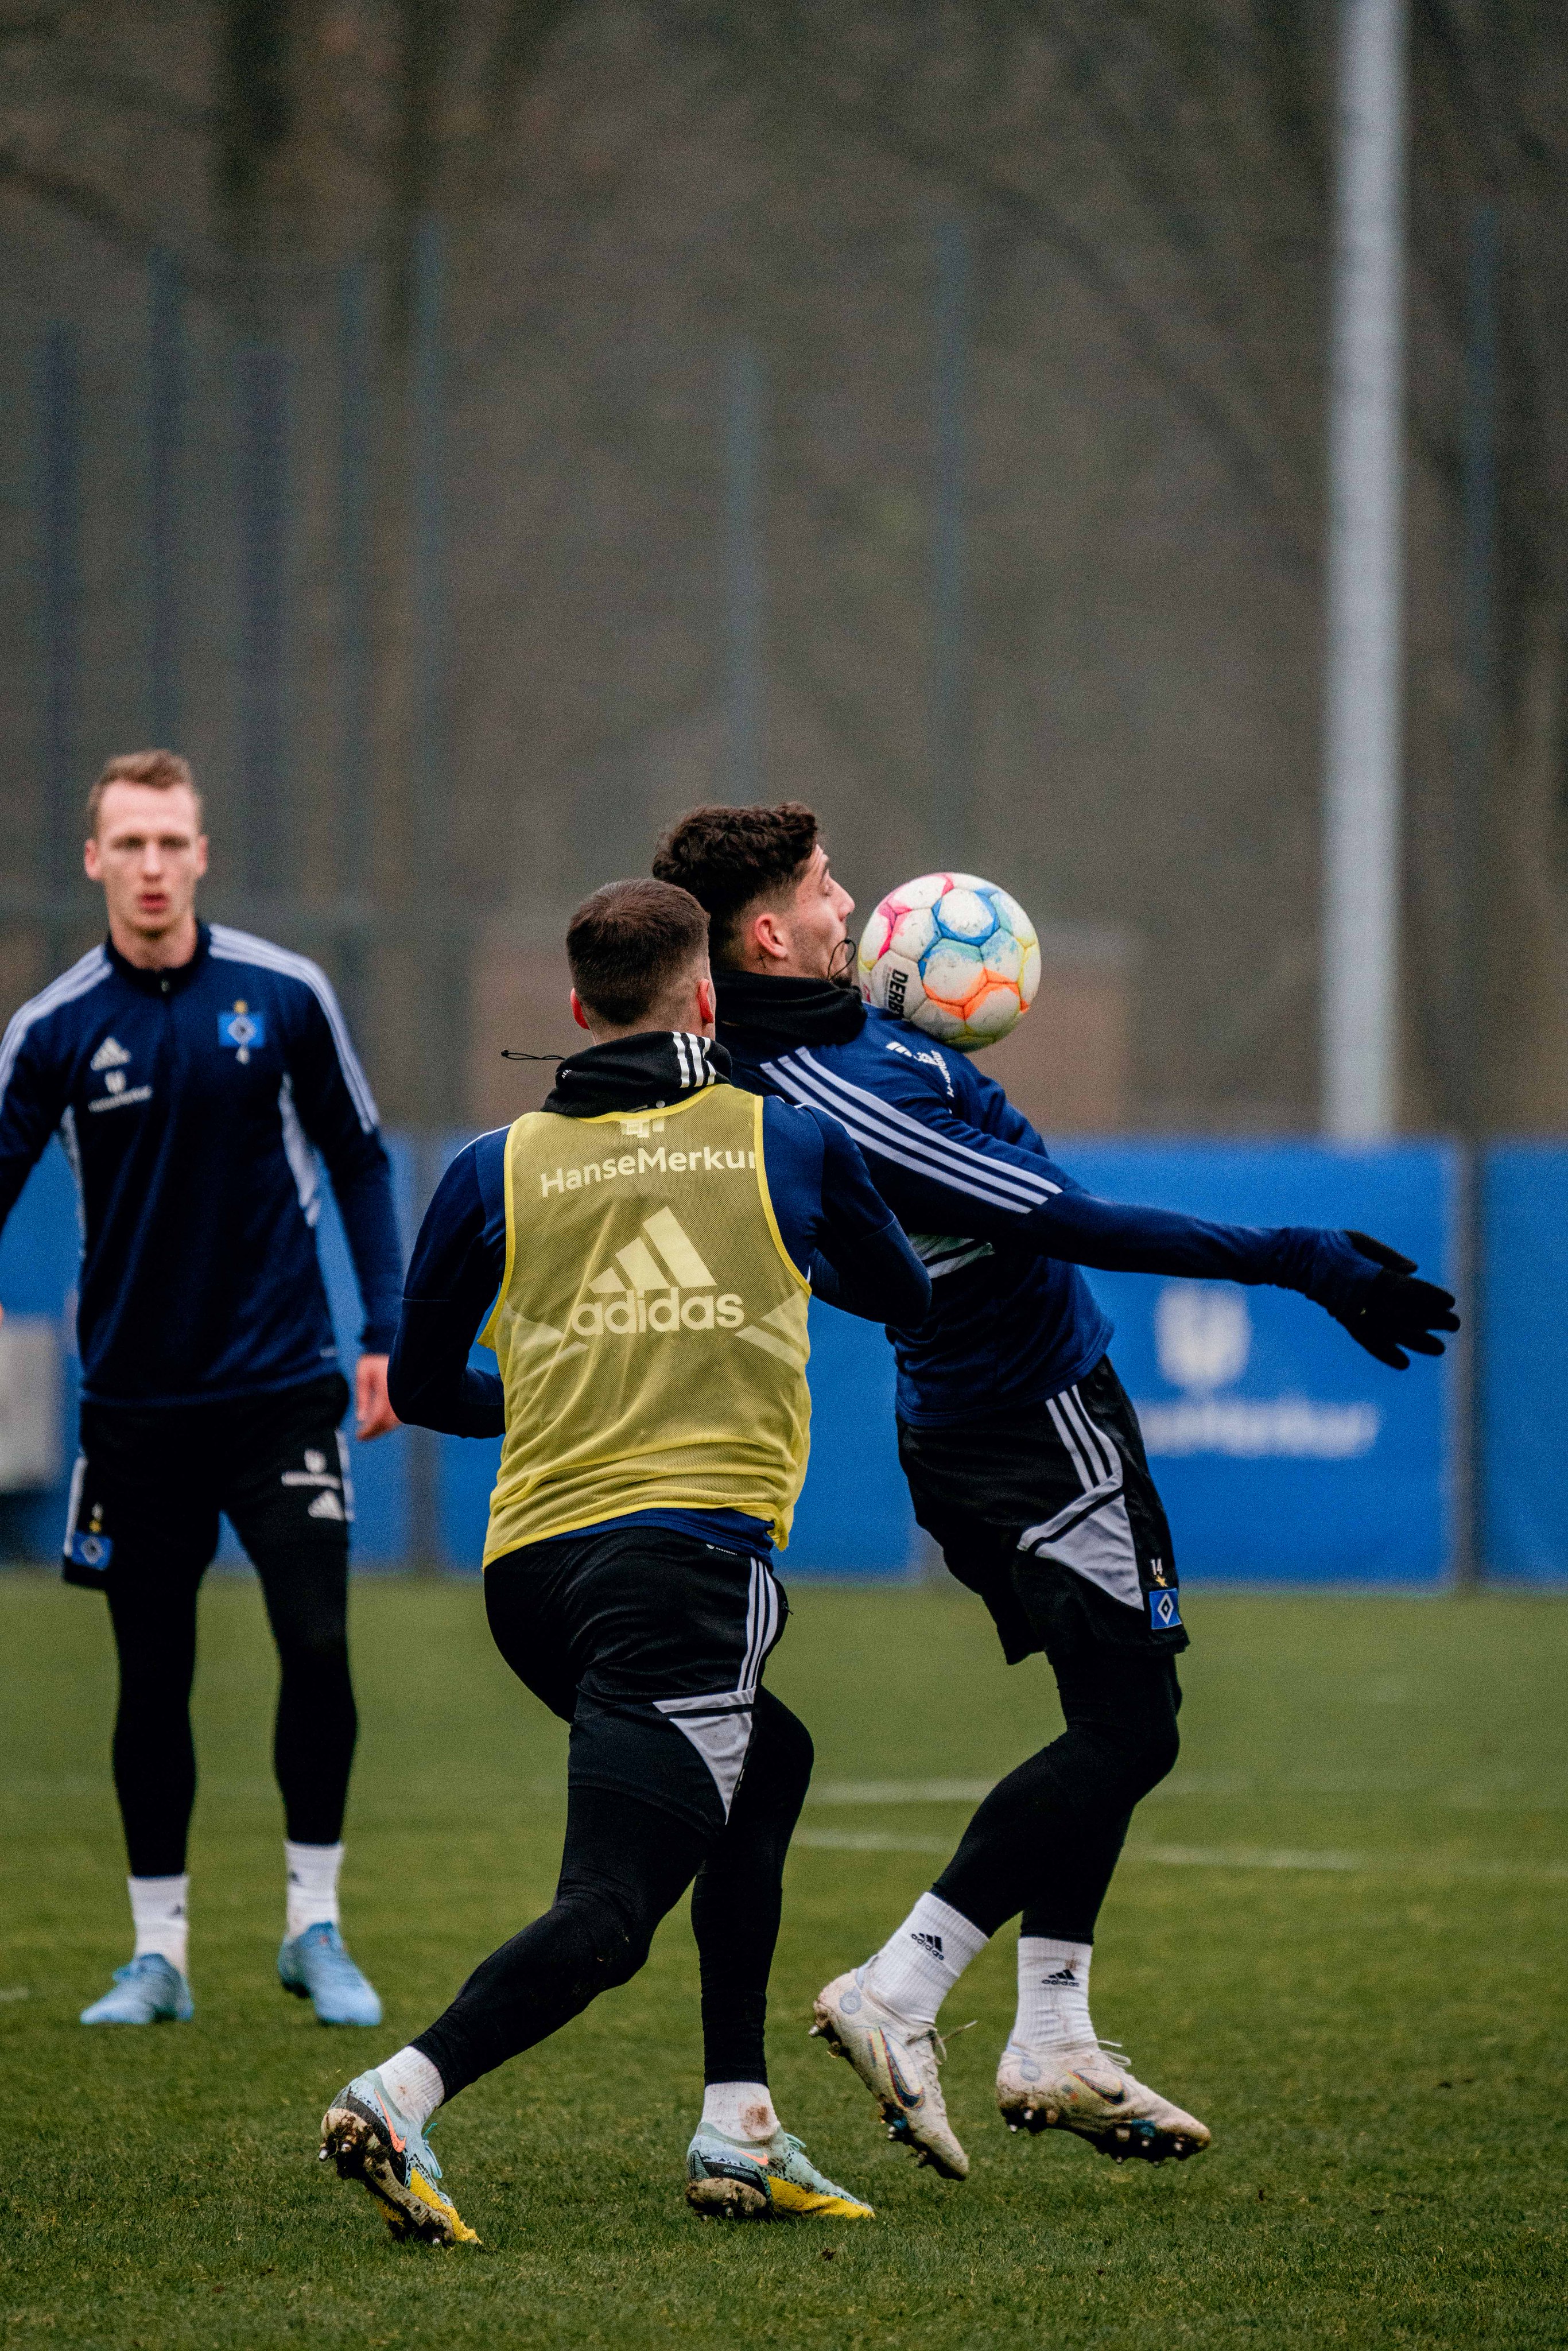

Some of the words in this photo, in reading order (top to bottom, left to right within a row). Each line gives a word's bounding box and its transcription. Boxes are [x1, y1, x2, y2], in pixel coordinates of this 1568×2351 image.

[572, 1286, 745, 1336] adidas
[1150, 1558, 1163, 1576] 14
[911, 1933, 944, 1961] adidas
[1042, 1978, 1080, 1987] adidas
